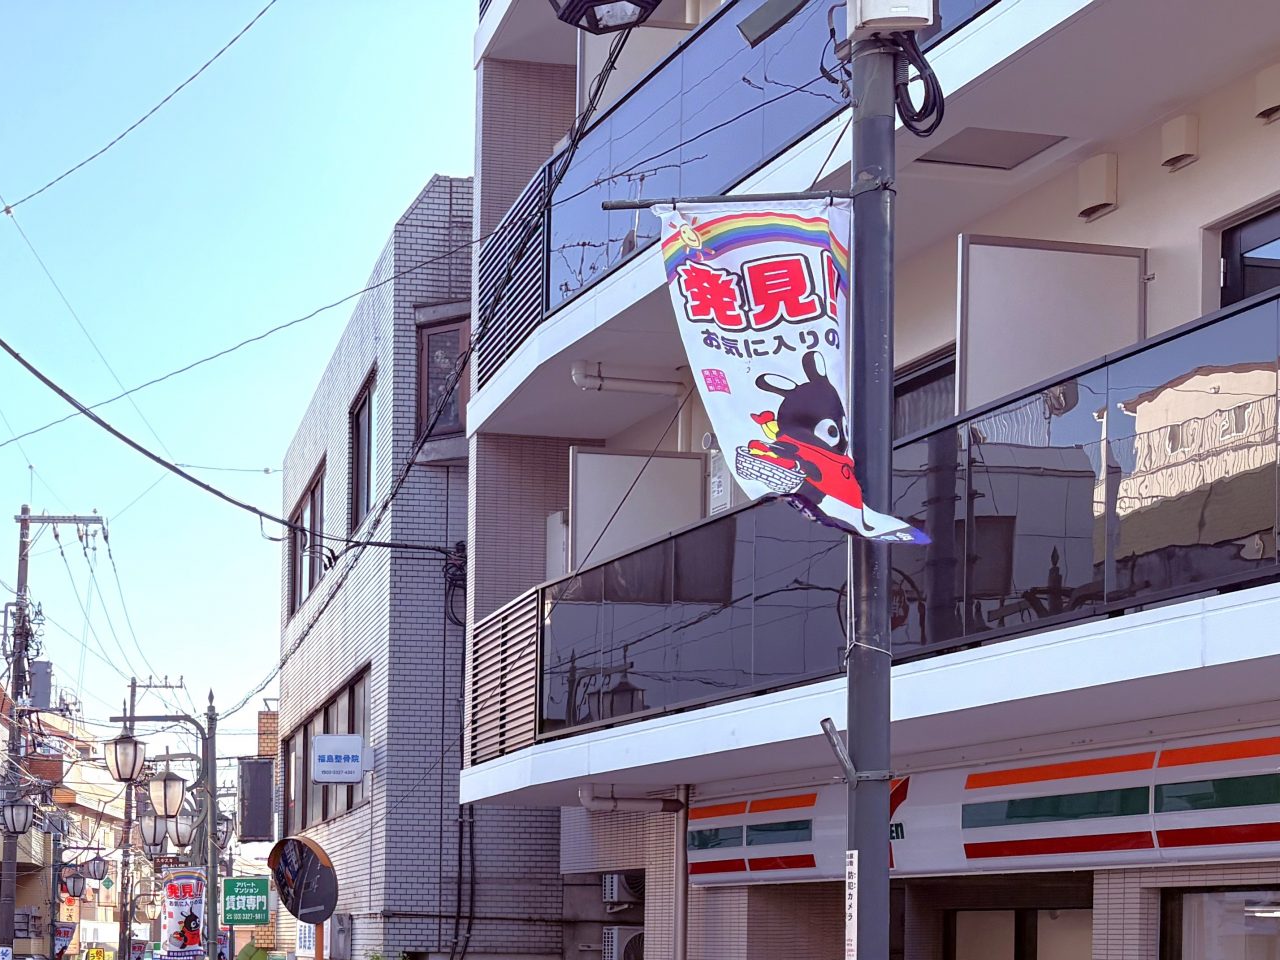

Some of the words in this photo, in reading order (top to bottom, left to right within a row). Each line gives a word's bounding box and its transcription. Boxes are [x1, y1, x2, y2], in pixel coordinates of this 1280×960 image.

[318, 754, 360, 763] 福島整骨院
[225, 895, 267, 911] 賃貸専門
